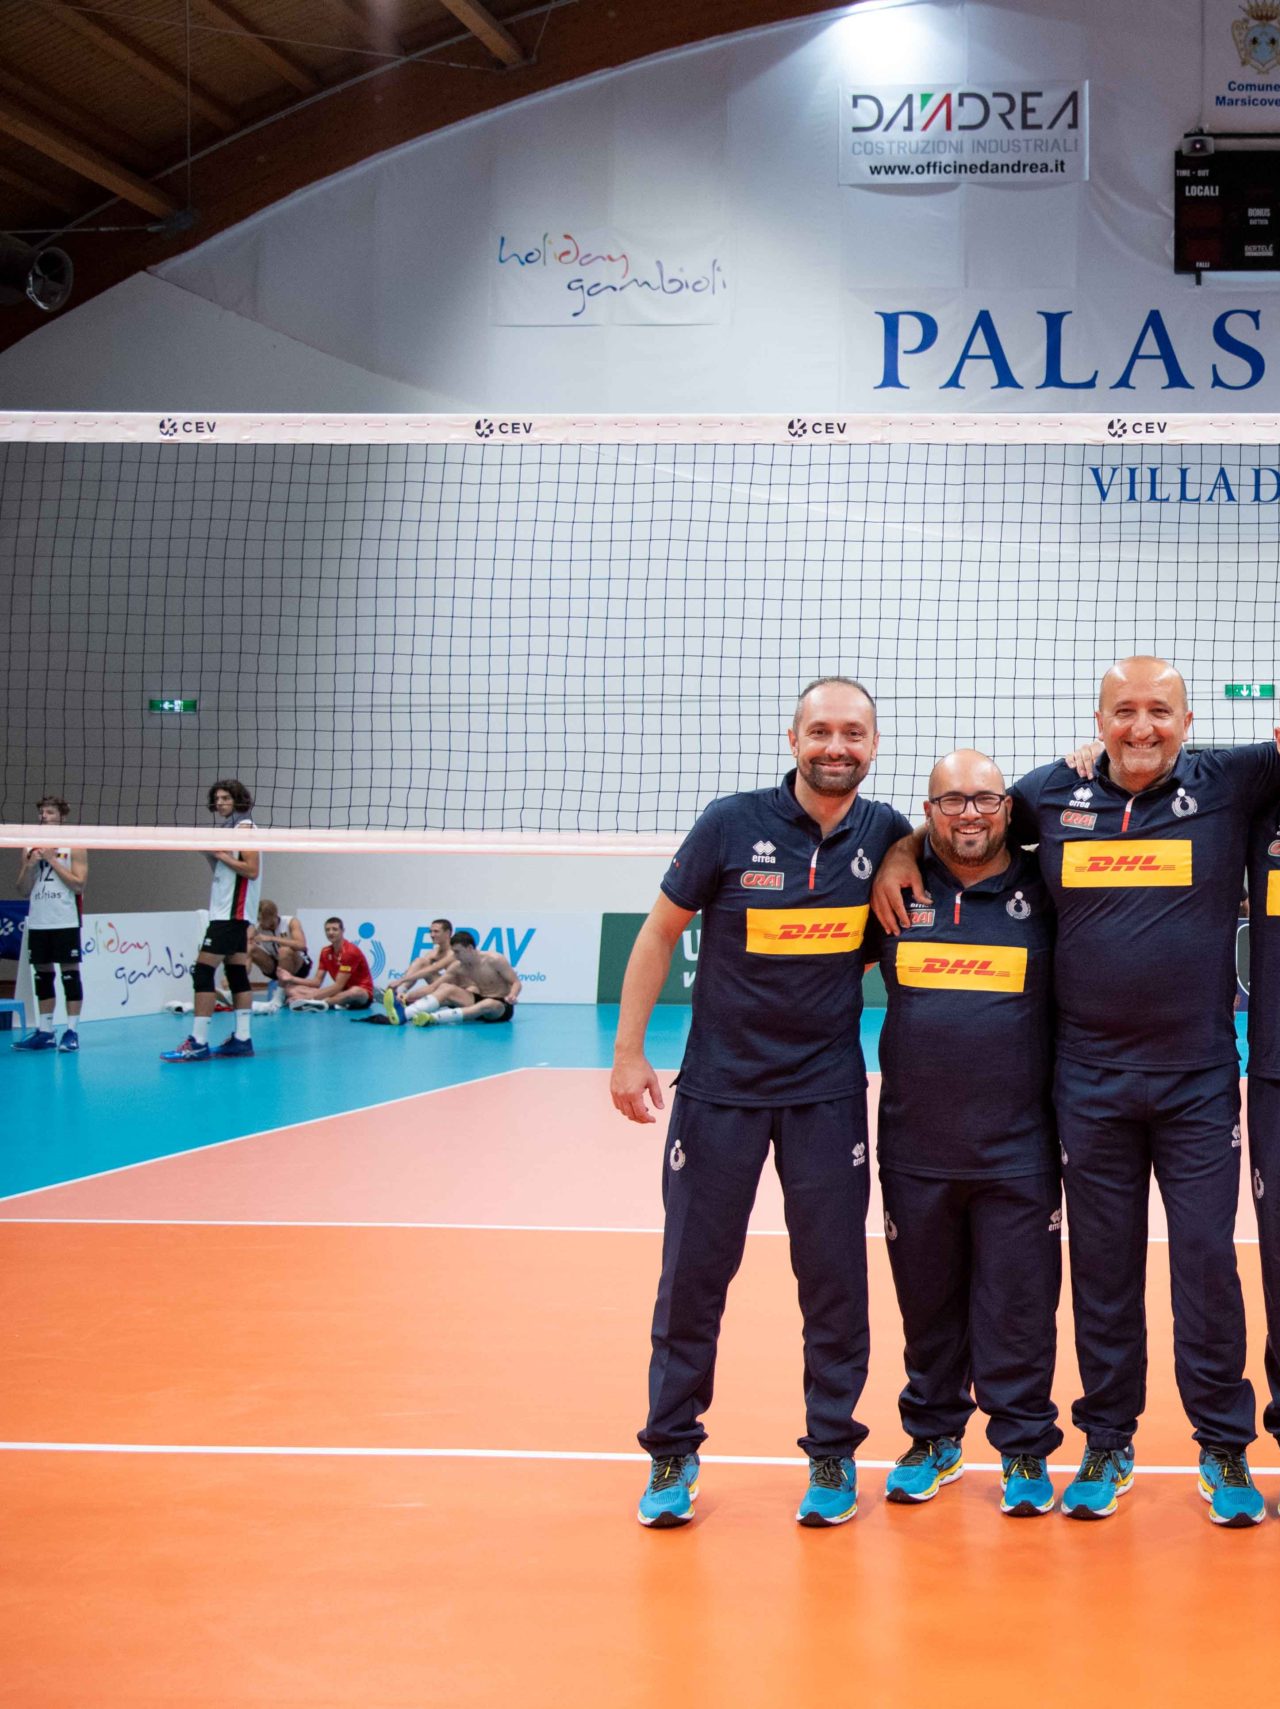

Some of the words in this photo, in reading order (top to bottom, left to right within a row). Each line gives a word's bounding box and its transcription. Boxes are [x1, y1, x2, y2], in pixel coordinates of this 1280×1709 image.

[1228, 81, 1280, 92] Comune
[852, 139, 964, 155] COSTRUZIONI
[972, 138, 1079, 153] INDUSTRIALI
[869, 159, 1066, 175] www.officinedandrea.it
[1185, 185, 1219, 196] LOCALI
[498, 233, 629, 279] holiday
[567, 259, 727, 317] gambioli
[182, 422, 217, 433] CEV
[498, 422, 533, 433] CEV
[811, 422, 847, 433] CEV
[1131, 422, 1168, 434] CEV
[1088, 467, 1238, 503] VILLA
[1087, 855, 1161, 872] DHL
[743, 873, 782, 887] CRAI
[778, 922, 851, 940] DHL
[921, 958, 996, 976] DHL
[514, 971, 546, 981] avolo
